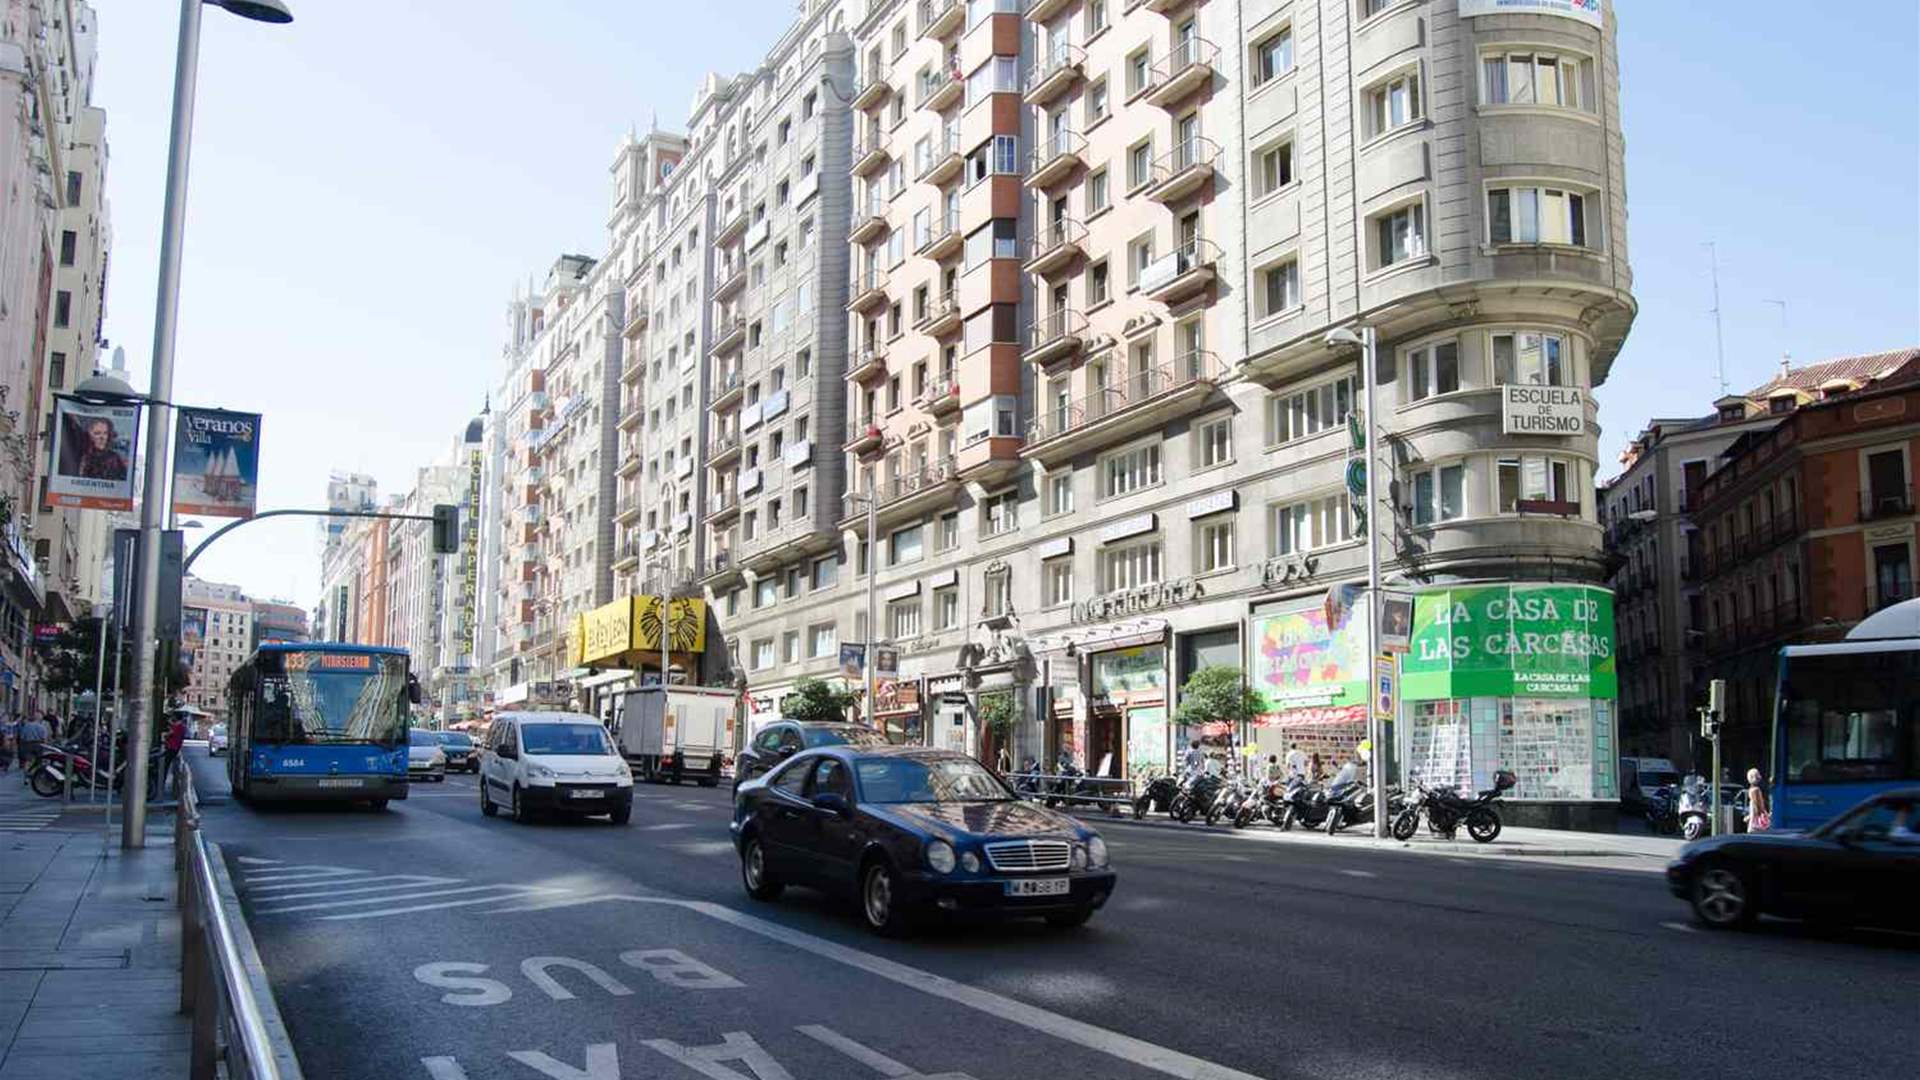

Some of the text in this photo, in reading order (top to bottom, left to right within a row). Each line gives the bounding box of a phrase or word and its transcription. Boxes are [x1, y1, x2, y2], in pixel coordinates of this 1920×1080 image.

[1510, 388, 1580, 405] ESCUELA
[1538, 405, 1552, 415] DE
[185, 414, 253, 433] Veranos
[1511, 415, 1580, 431] TURISMO
[187, 430, 212, 444] Villa
[463, 449, 481, 654] HOTEL EMPERADOR
[1434, 599, 1599, 625] LA CASA DE
[1419, 630, 1609, 661] LAS CARCASAS
[1514, 673, 1528, 681] LA
[413, 949, 748, 1006] BUS
